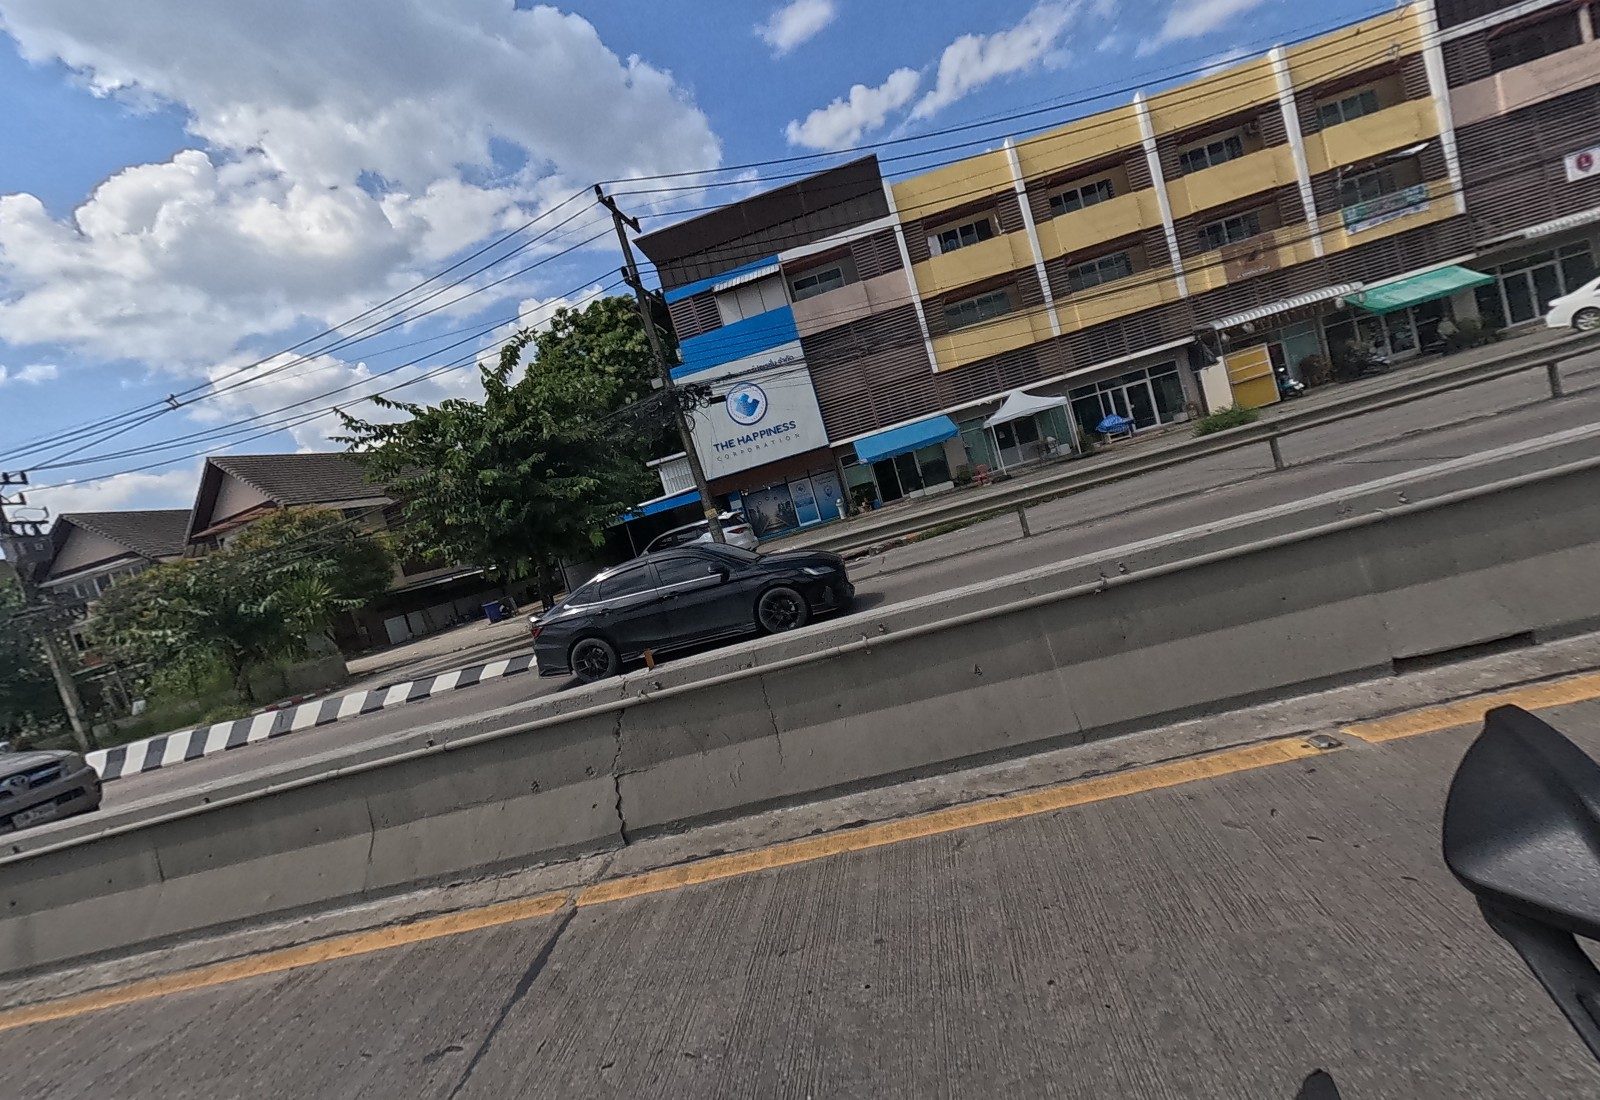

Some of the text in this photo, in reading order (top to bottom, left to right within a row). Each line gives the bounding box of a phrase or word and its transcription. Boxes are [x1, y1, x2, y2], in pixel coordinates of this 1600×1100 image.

[713, 420, 797, 452] THE HAPPINESS
[716, 433, 800, 462] CORPORATION
